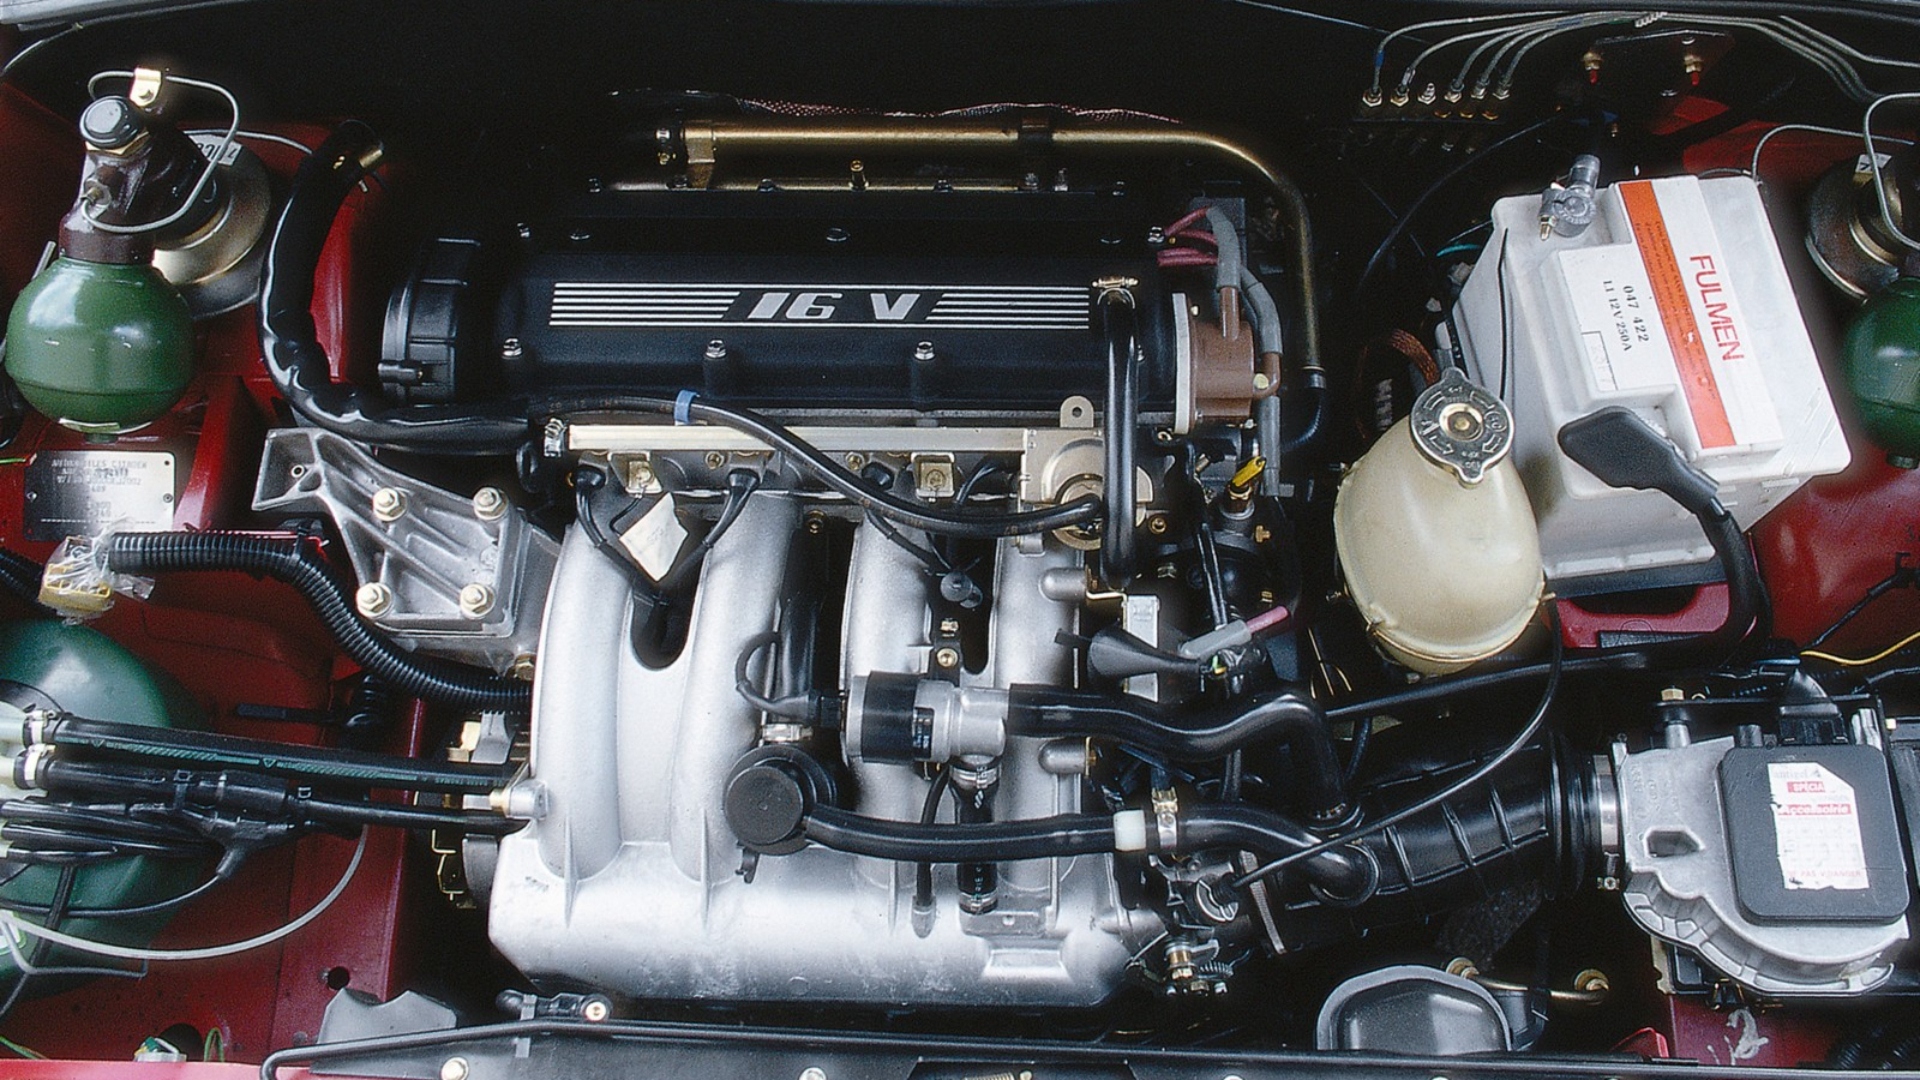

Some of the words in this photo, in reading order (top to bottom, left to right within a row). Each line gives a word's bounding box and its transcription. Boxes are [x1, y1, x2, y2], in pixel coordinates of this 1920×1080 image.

[747, 292, 843, 320] 16
[870, 293, 921, 320] V
[1623, 286, 1639, 309] 047
[1633, 317, 1649, 342] 422
[1690, 255, 1744, 361] FULMEN
